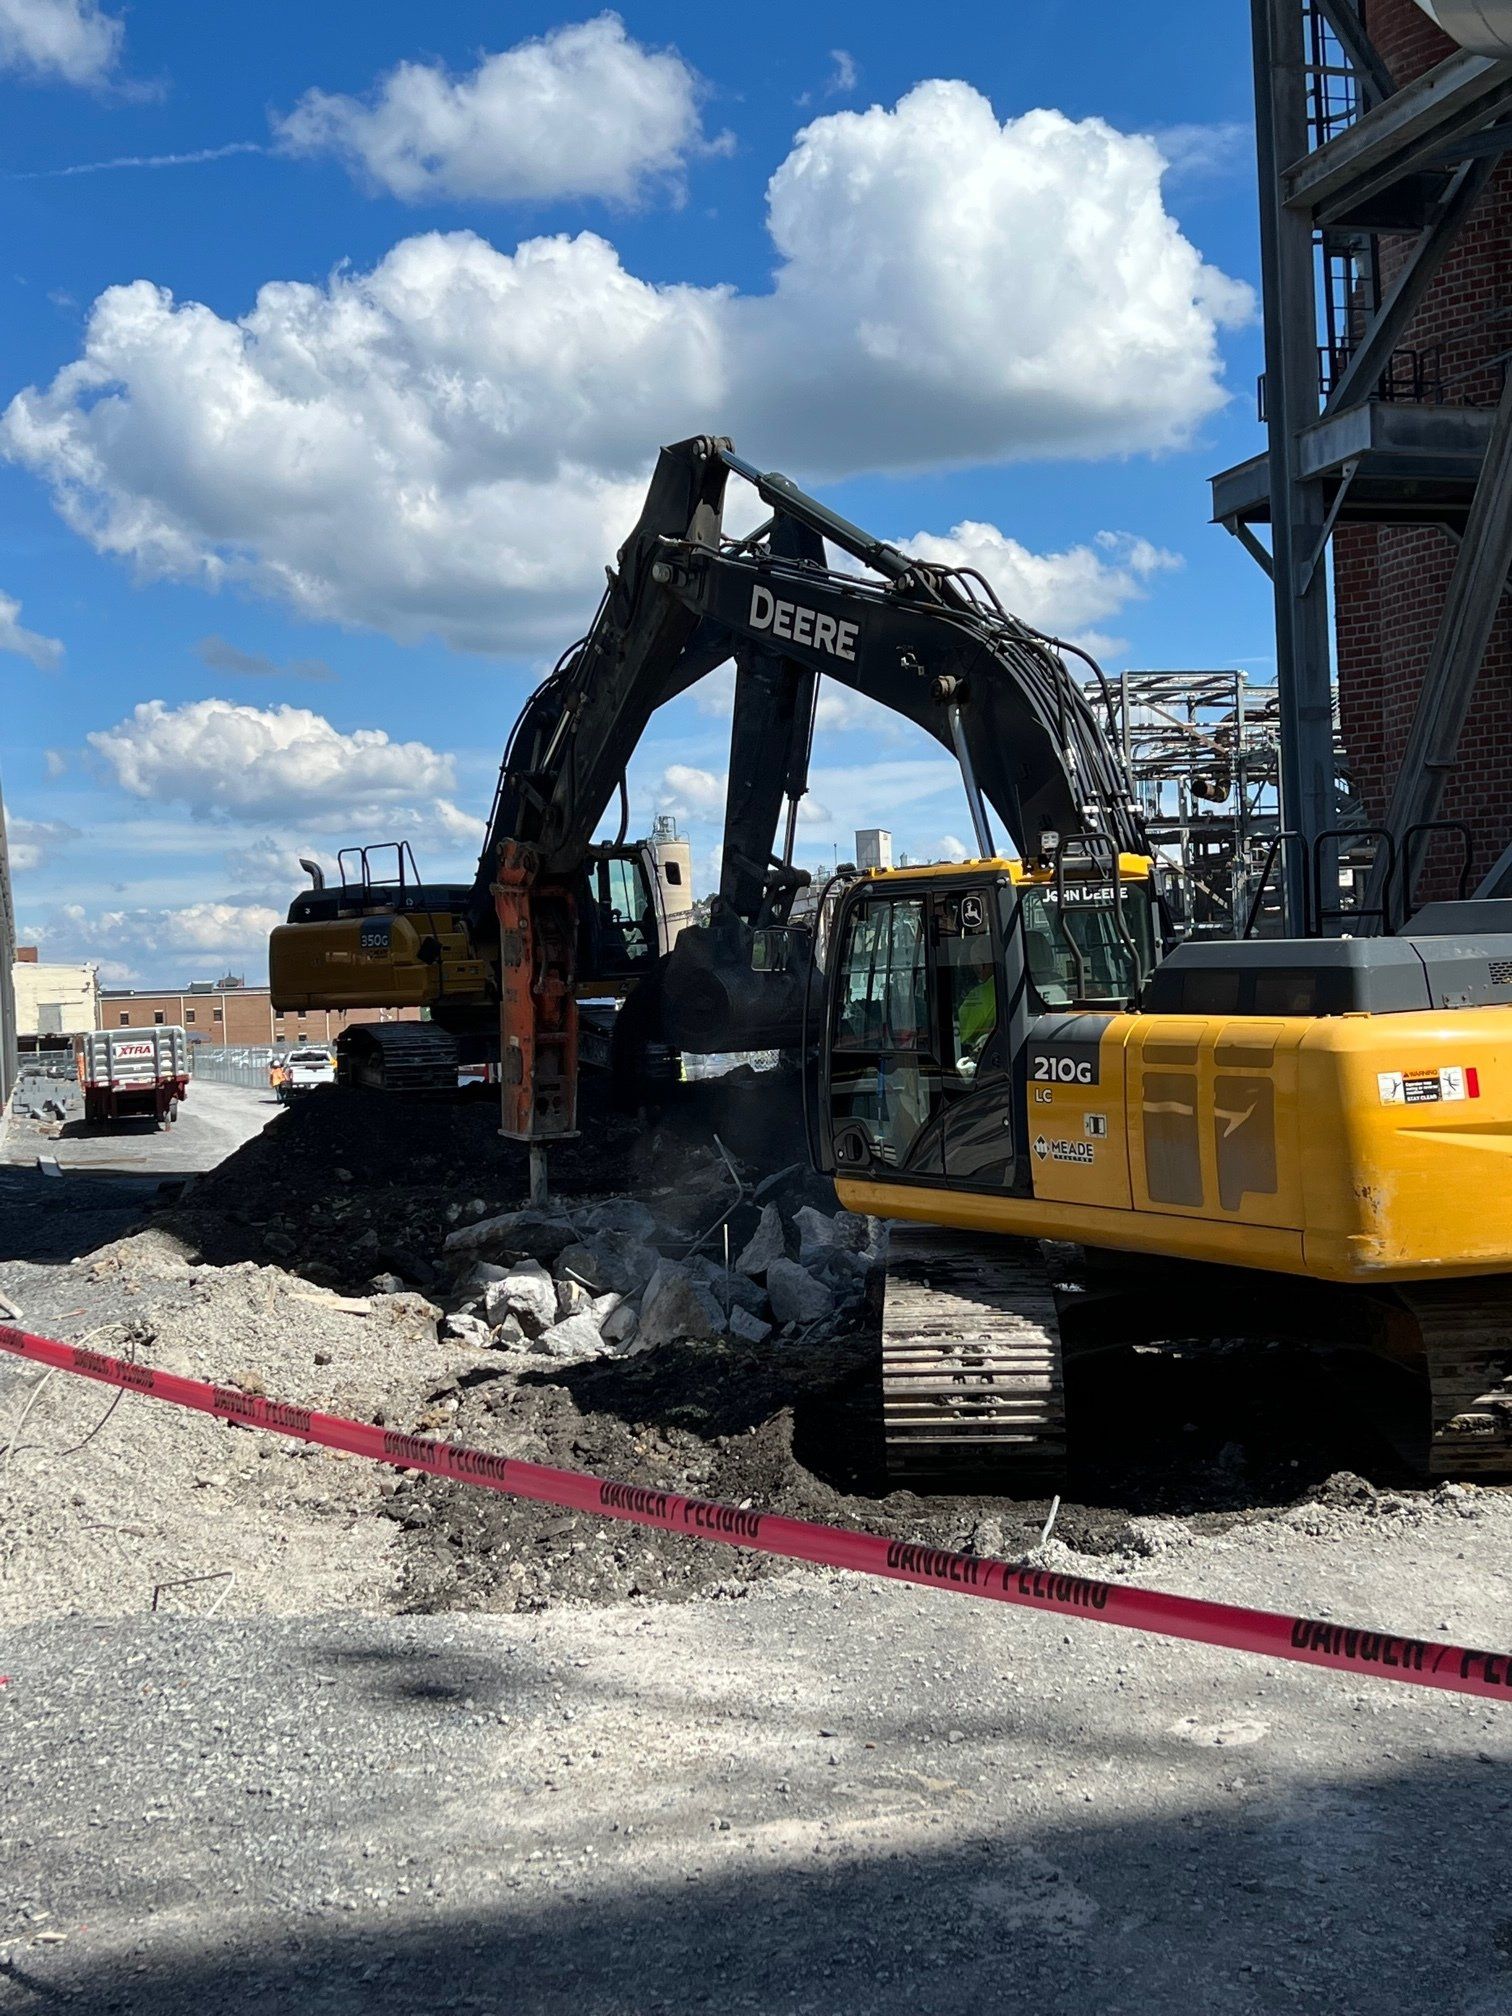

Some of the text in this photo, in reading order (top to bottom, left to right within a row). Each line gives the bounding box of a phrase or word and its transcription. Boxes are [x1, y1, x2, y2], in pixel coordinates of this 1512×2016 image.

[749, 584, 859, 661] DEERE
[361, 934, 388, 947] 350G
[118, 1045, 151, 1057] XTRA
[1034, 1056, 1092, 1083] 210G
[1035, 1089, 1052, 1103] LC
[1051, 1141, 1094, 1157] MEADE
